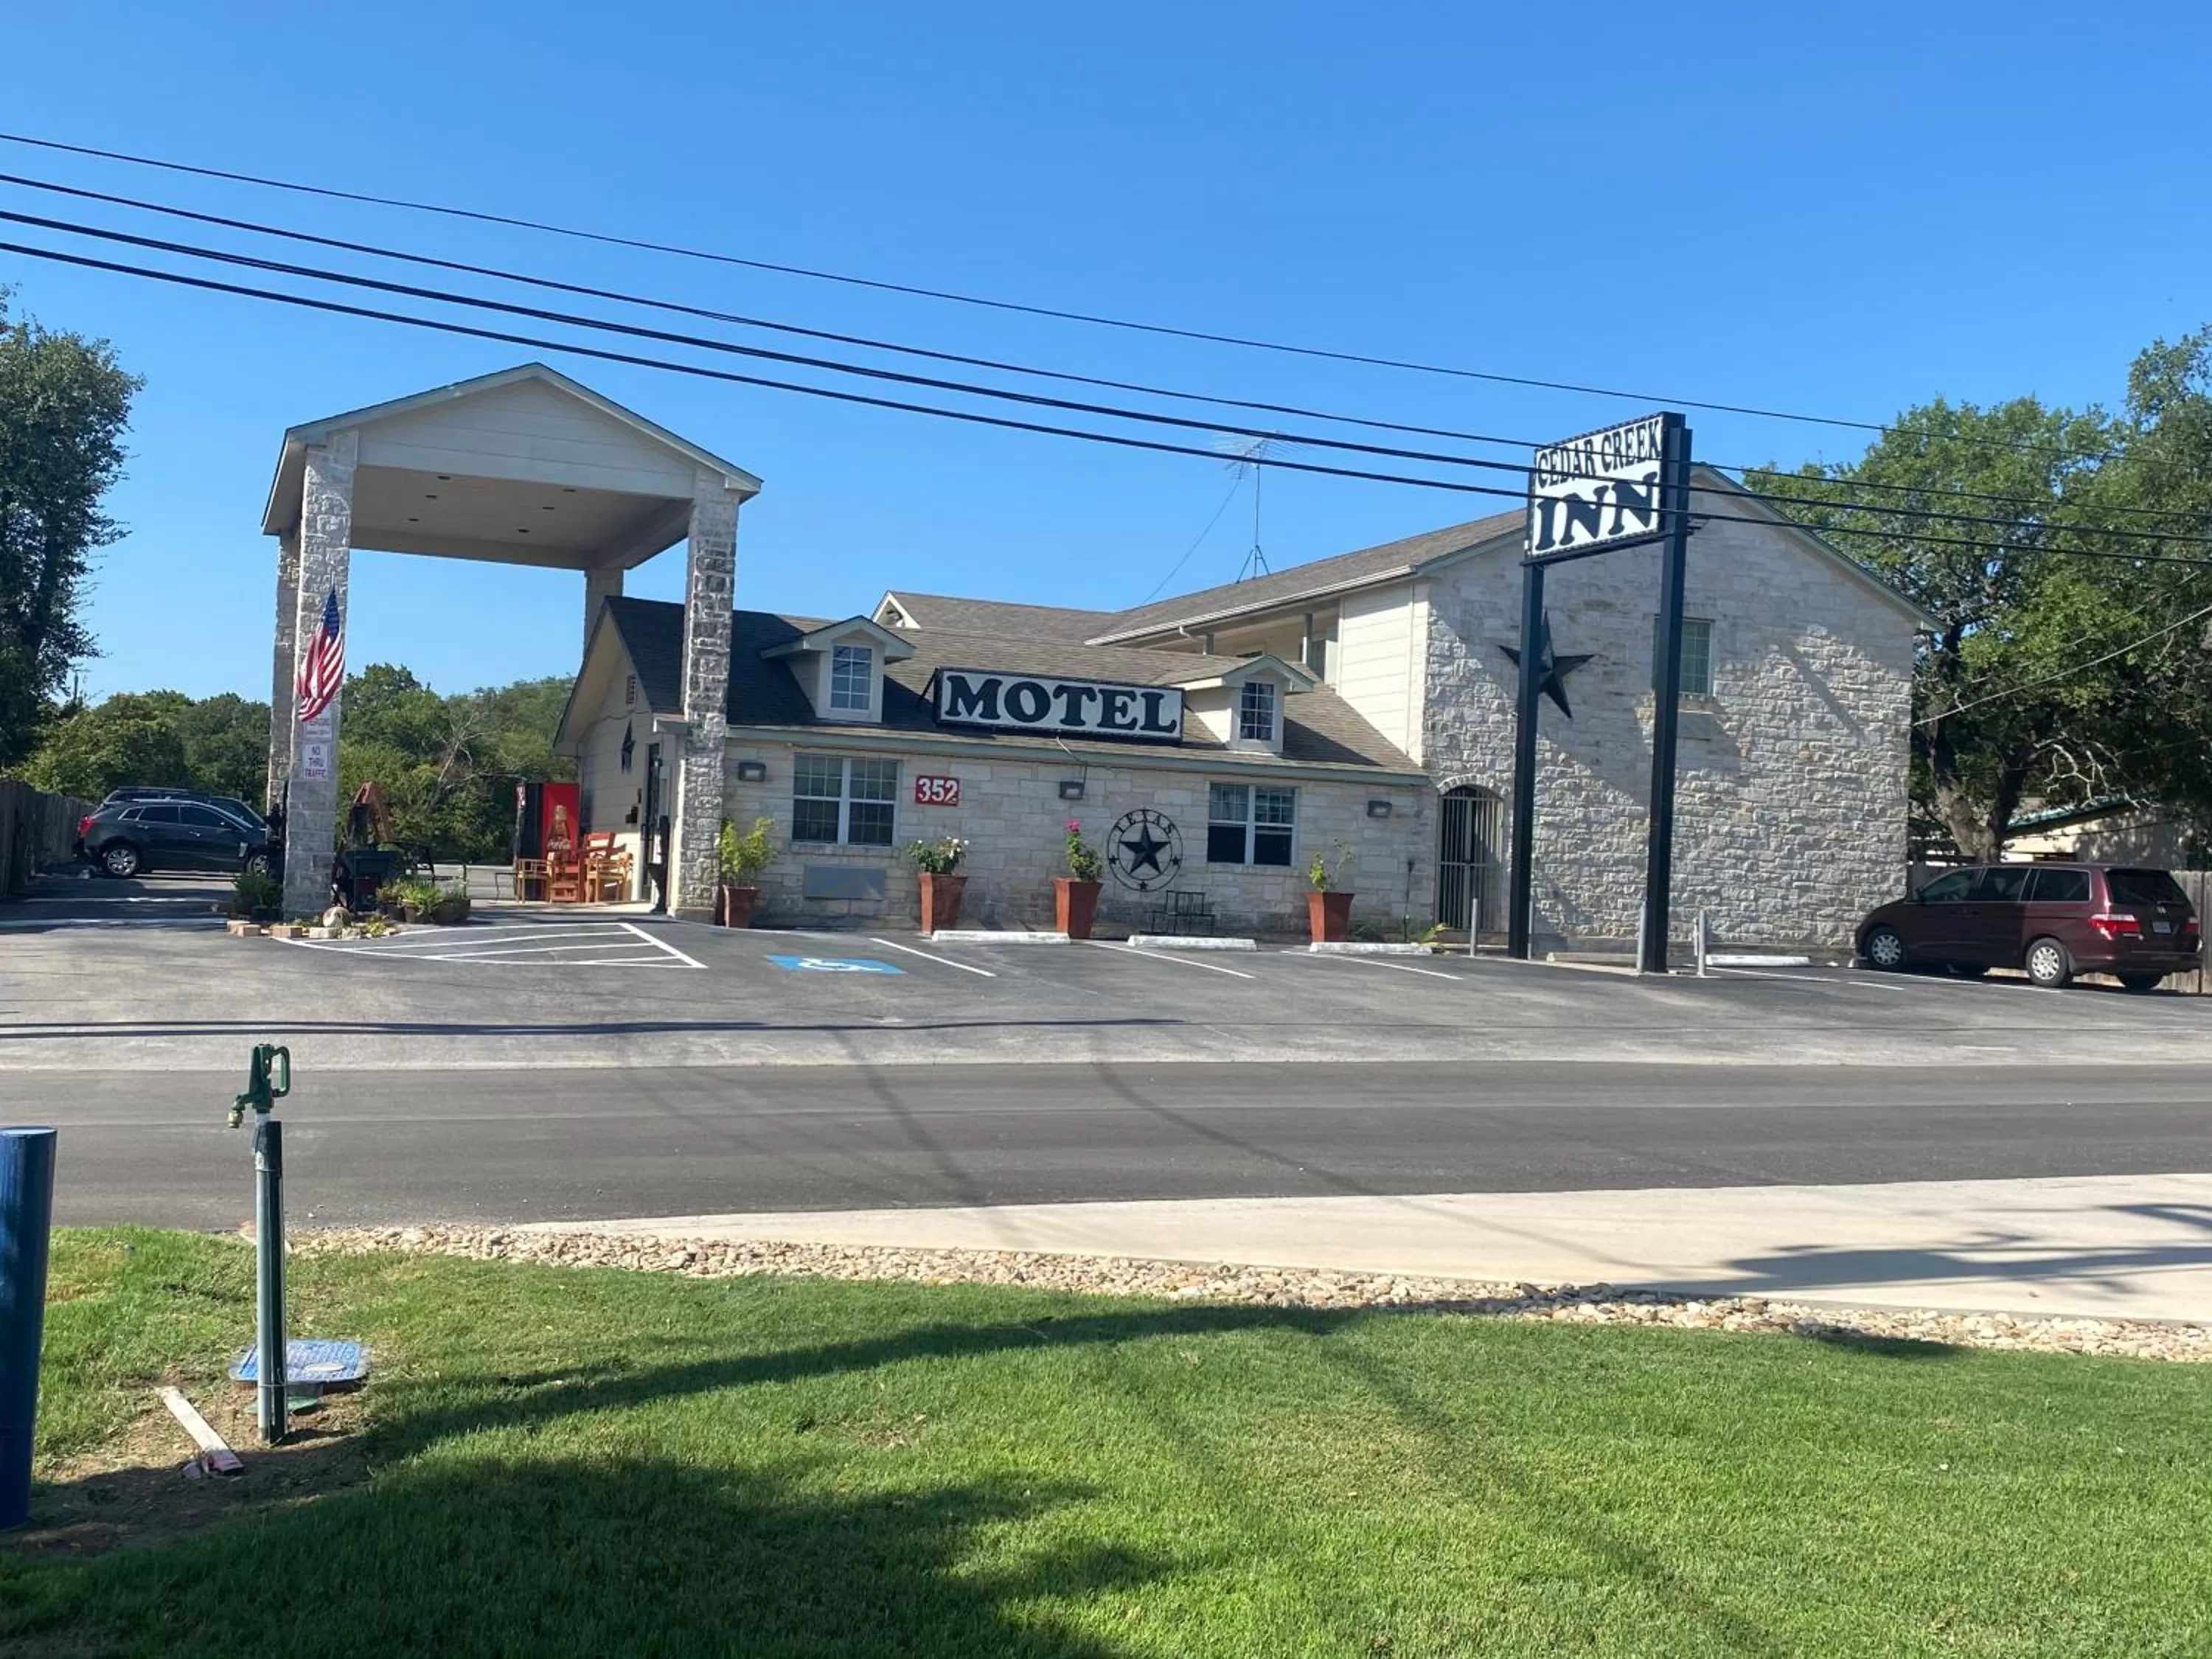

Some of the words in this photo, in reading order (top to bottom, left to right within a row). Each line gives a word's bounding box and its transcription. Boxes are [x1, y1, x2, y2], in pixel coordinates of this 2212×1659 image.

[1537, 438, 1596, 488] CEDAR
[1601, 420, 1660, 473] CREEK
[1535, 472, 1658, 551] INN
[945, 675, 1178, 733] MOTEL
[917, 778, 958, 804] 352
[1114, 809, 1174, 835] TEXAS
